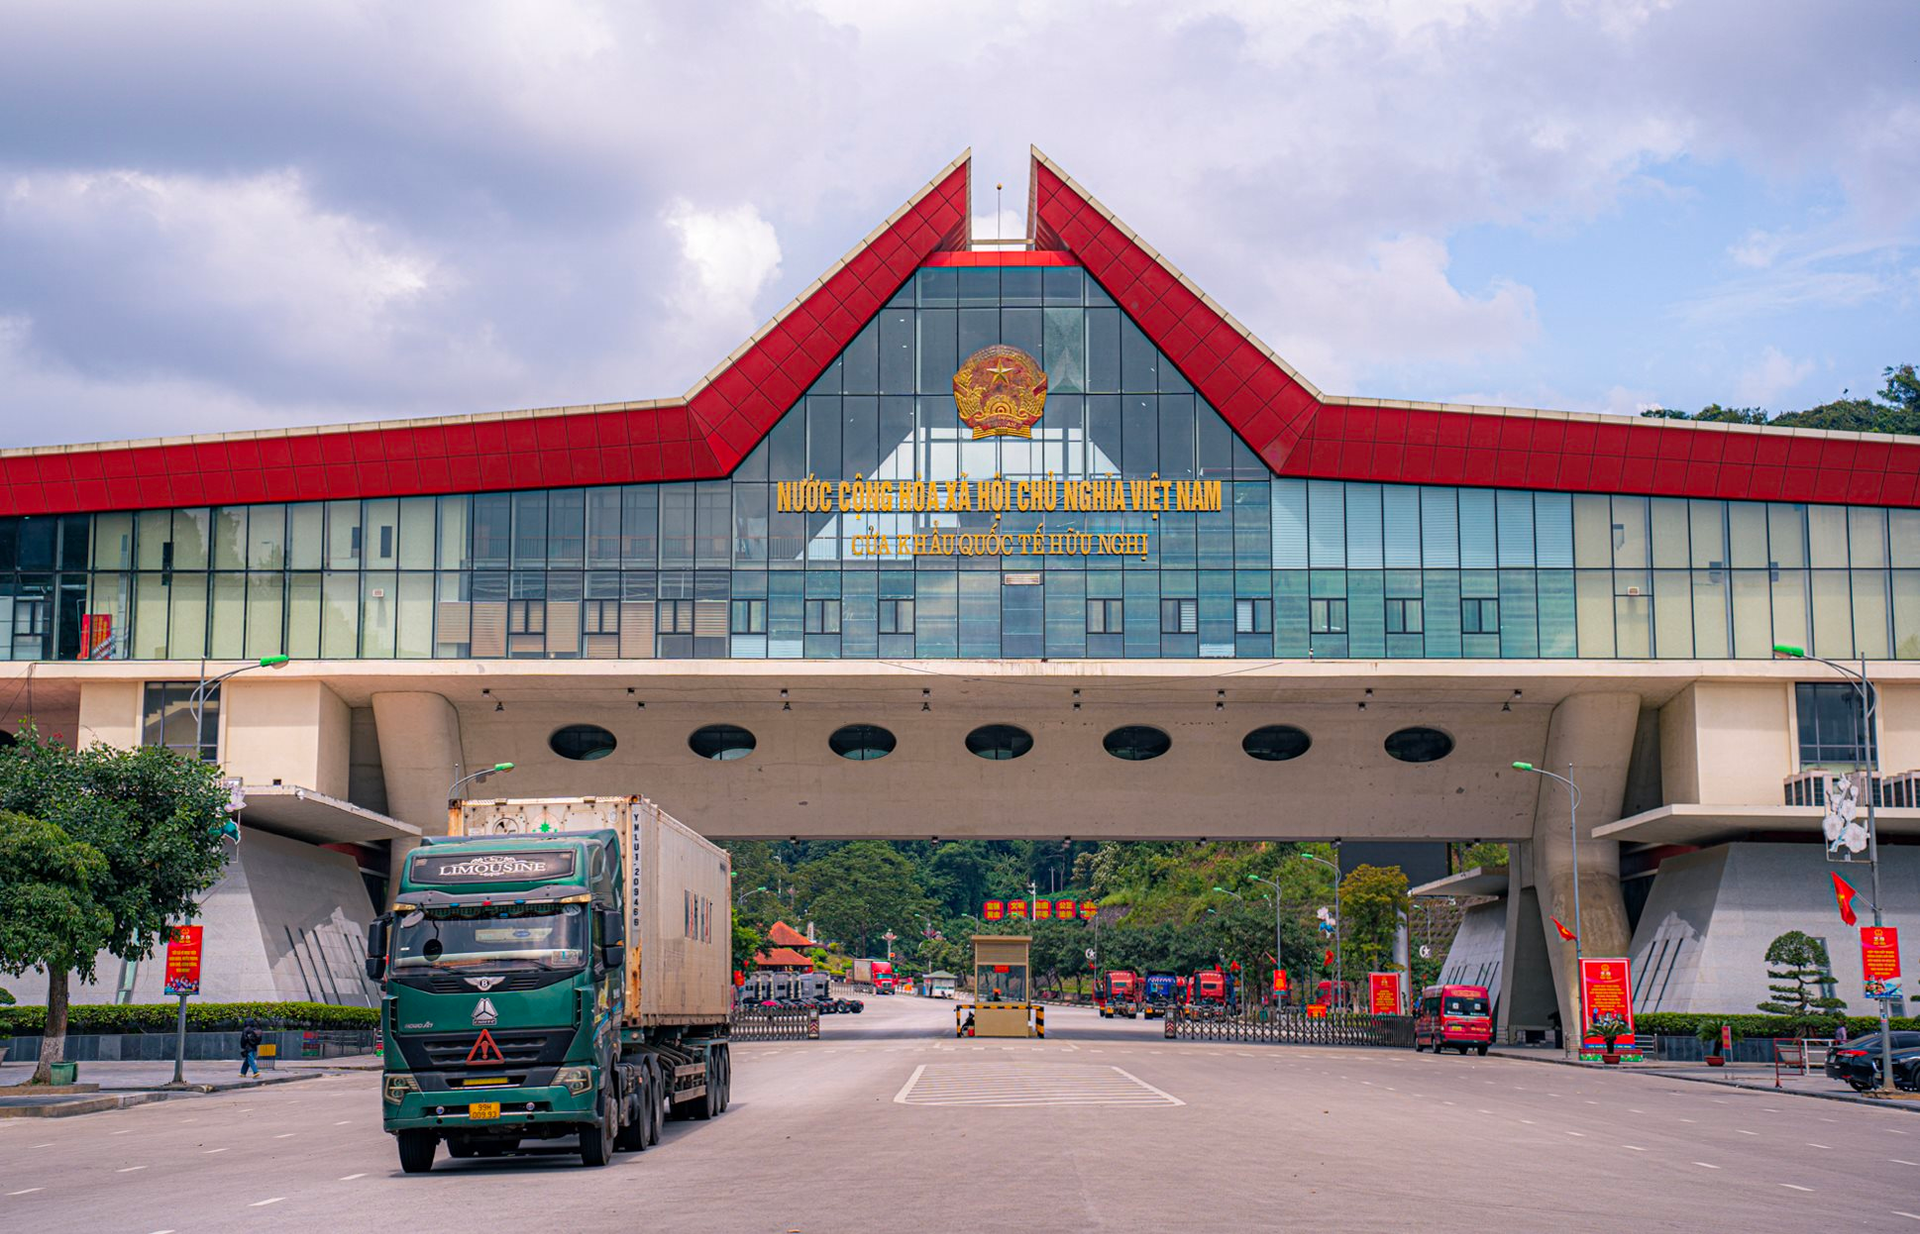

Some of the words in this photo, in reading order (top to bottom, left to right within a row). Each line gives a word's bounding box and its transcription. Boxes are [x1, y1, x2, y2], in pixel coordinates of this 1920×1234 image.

[777, 473, 832, 512] NƯỚC
[838, 472, 893, 520] CỘNG
[899, 472, 941, 512] HÒA
[944, 472, 971, 512] XÃ
[977, 472, 1011, 520] HỘI
[1016, 470, 1057, 511] CHỦ
[1063, 472, 1126, 511] NGHĨA
[1130, 472, 1172, 520] VIỆT
[1176, 480, 1221, 511] NAM
[851, 525, 892, 555] CỬA
[896, 520, 954, 556] KHẨU
[958, 522, 1014, 557] QUỐC
[1018, 522, 1045, 555] TẾ
[1050, 527, 1093, 555] HỮU
[1097, 533, 1149, 561] NGHỊ
[439, 861, 547, 877] LIMOUSINE
